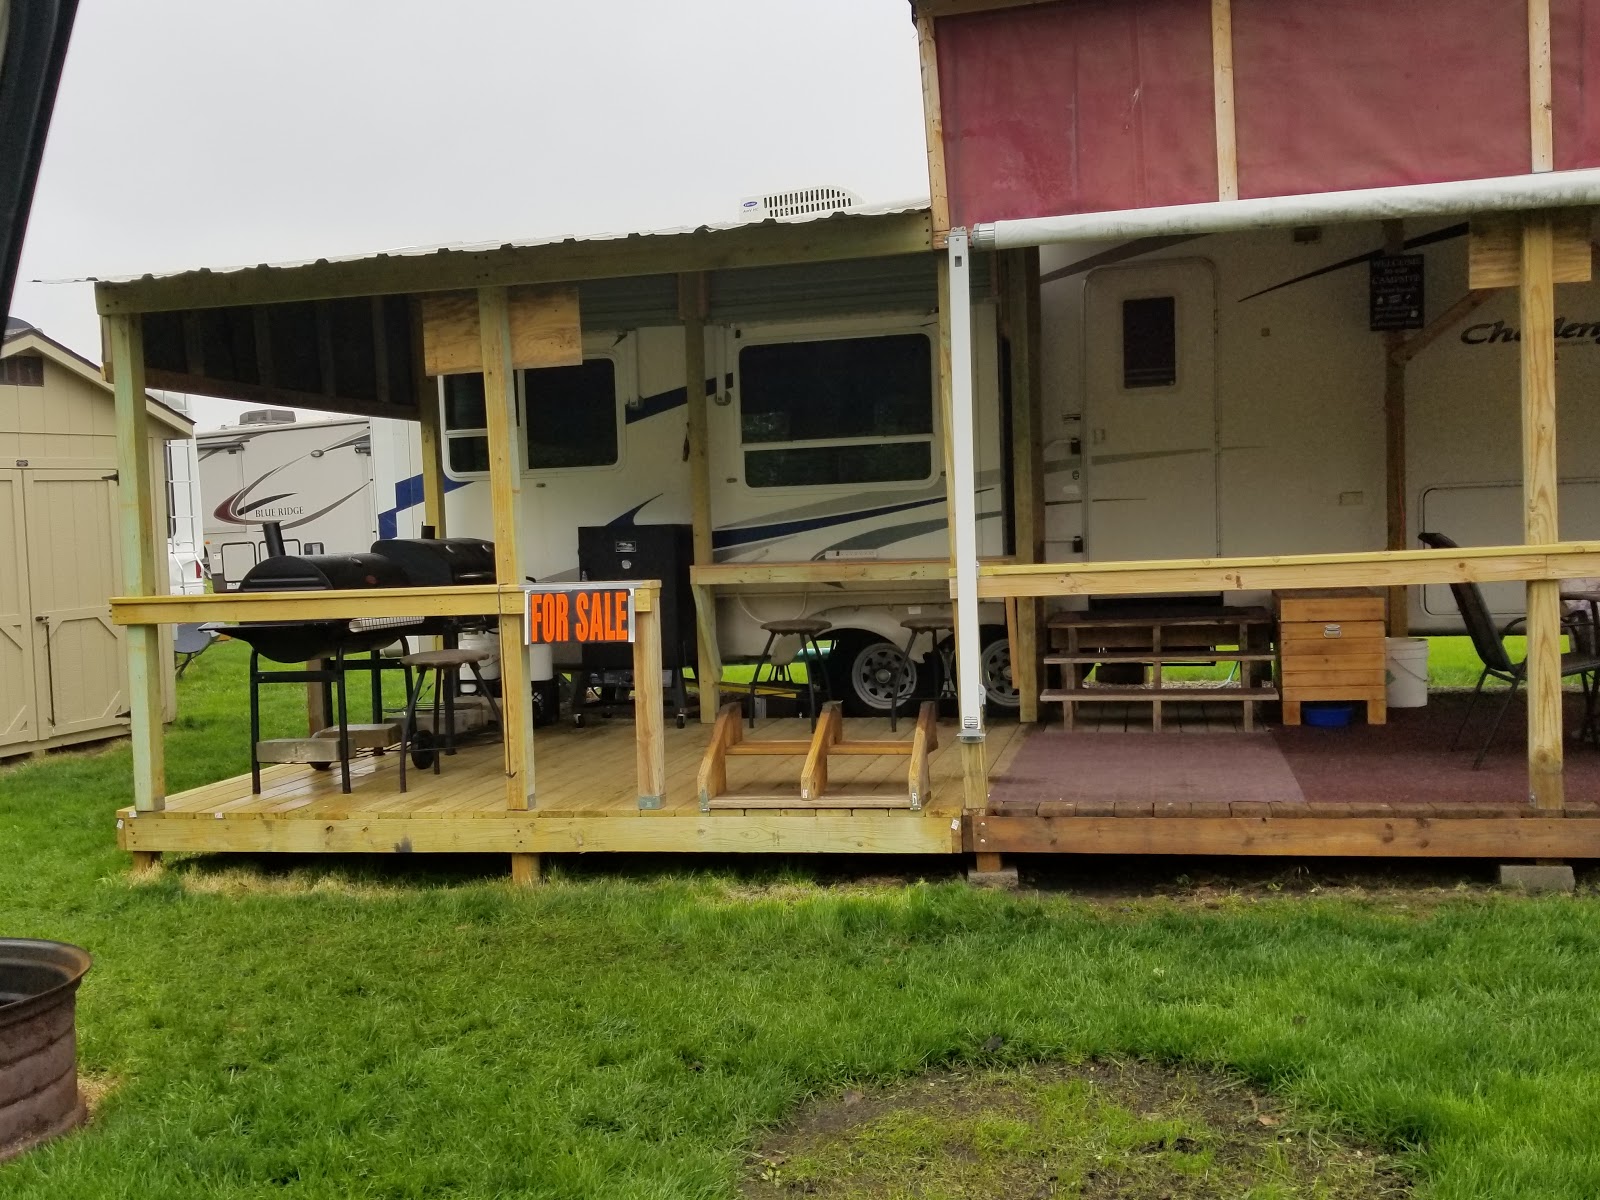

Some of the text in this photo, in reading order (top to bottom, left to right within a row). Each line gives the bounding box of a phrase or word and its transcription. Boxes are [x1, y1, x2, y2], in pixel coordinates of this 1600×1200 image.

[255, 506, 304, 518] BLUE RIDGE
[531, 592, 628, 642] FOR SALE
